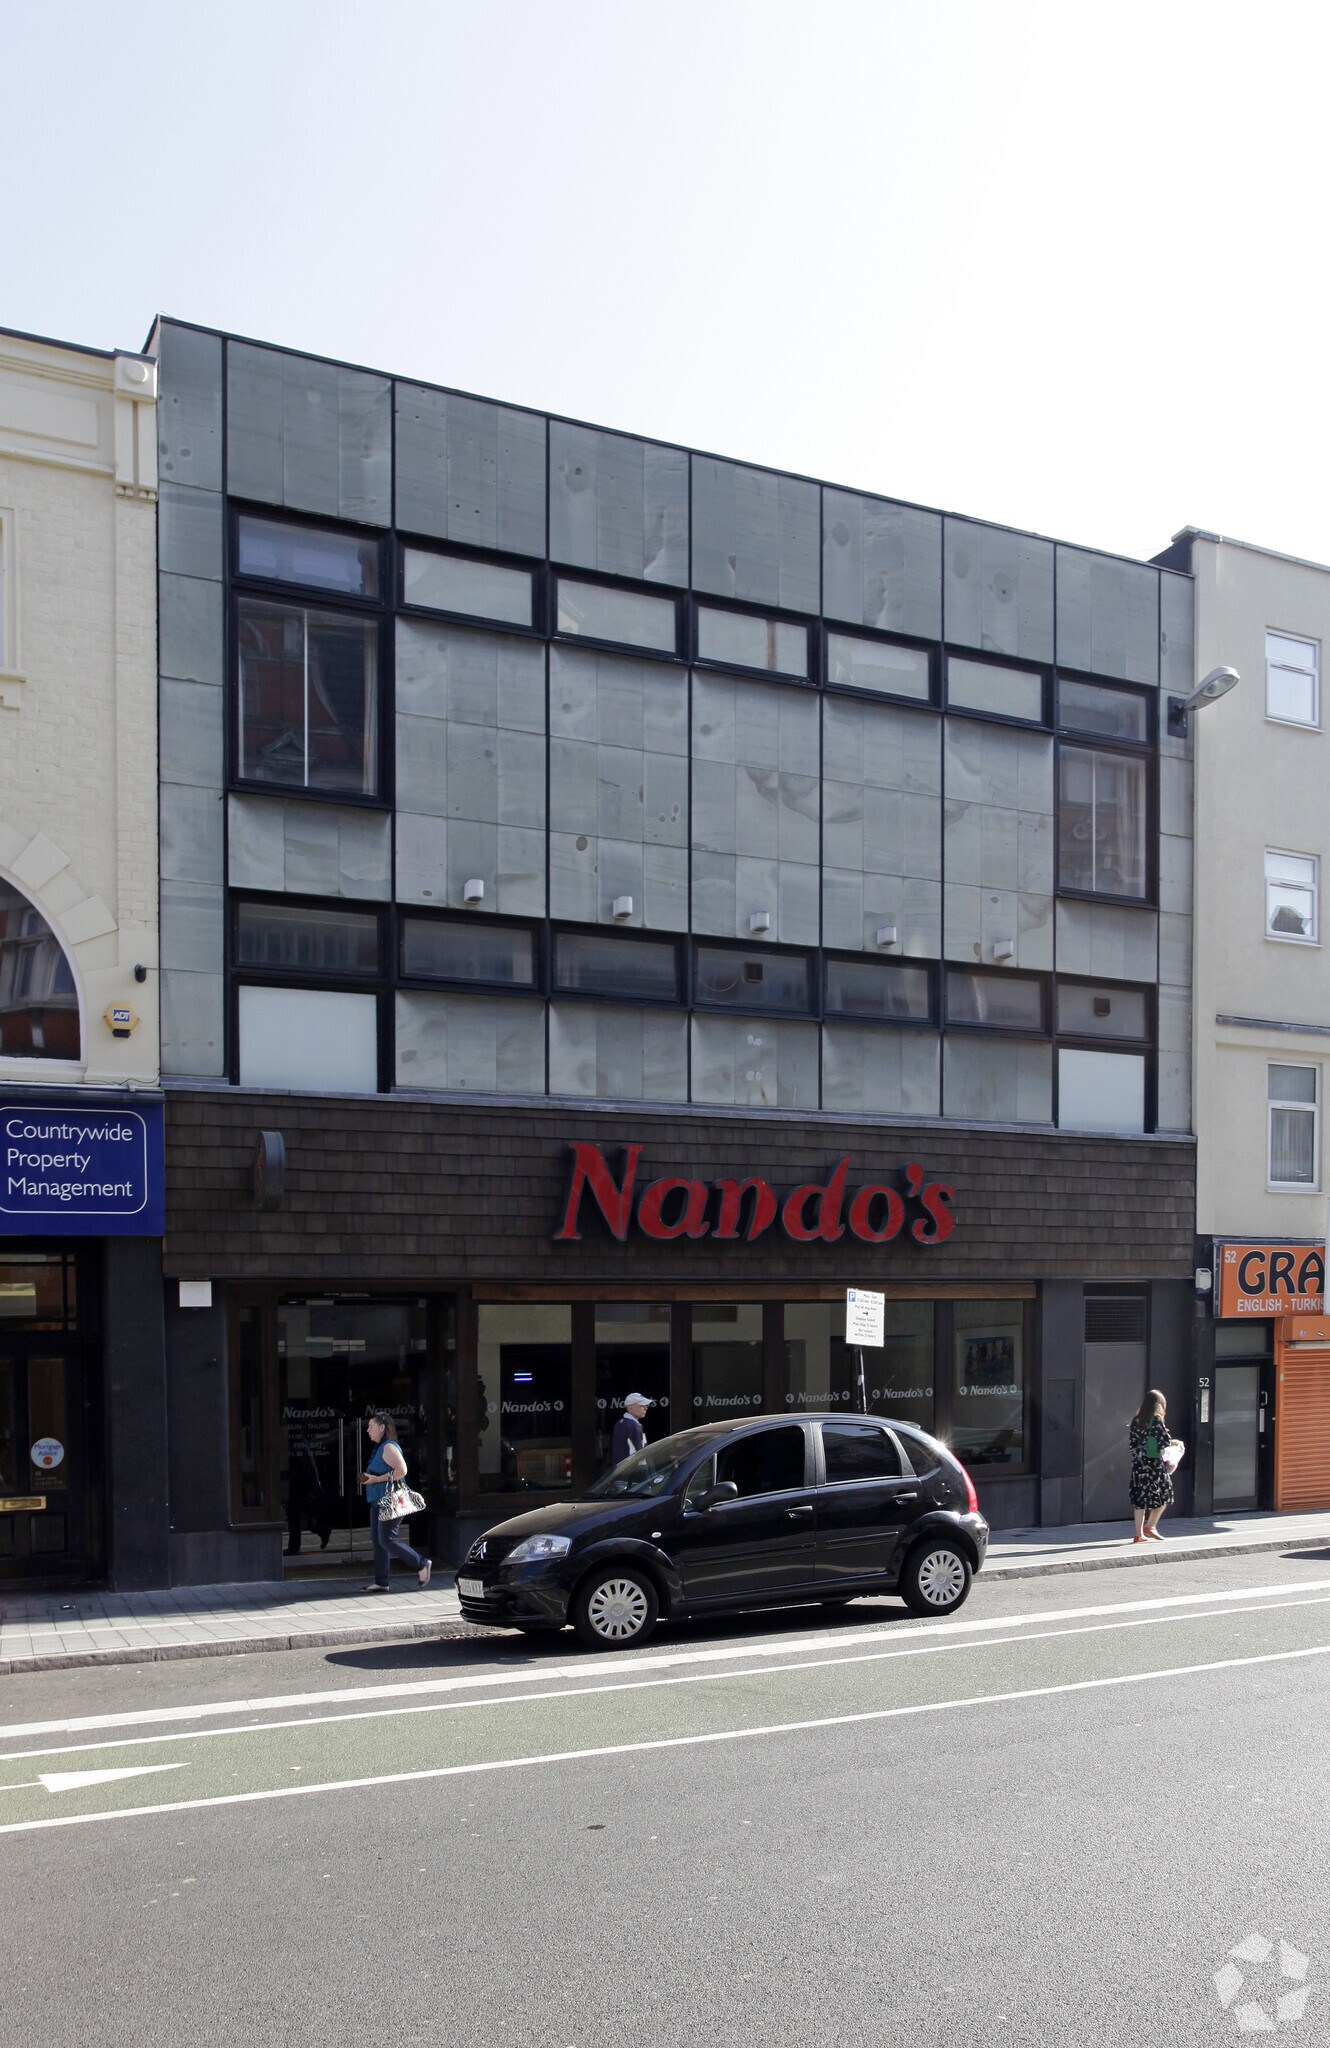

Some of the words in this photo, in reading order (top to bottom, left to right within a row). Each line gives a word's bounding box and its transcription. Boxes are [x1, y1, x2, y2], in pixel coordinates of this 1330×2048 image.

[113, 1011, 130, 1020] ADT
[6, 1119, 133, 1145] Countrywide
[7, 1148, 91, 1173] Property
[8, 1177, 133, 1201] Management
[552, 1142, 957, 1245] Nando's
[1224, 1250, 1237, 1263] 52
[1237, 1249, 1325, 1296] GRA
[1237, 1299, 1282, 1312] ENGLISH
[1199, 1377, 1210, 1387] 52
[883, 1387, 924, 1399] Nando's
[970, 1384, 1008, 1396] Nando's
[706, 1395, 751, 1407] Nando's
[797, 1391, 840, 1404] Nando's
[282, 1406, 336, 1419] Nando's
[501, 1400, 551, 1413] Nando's
